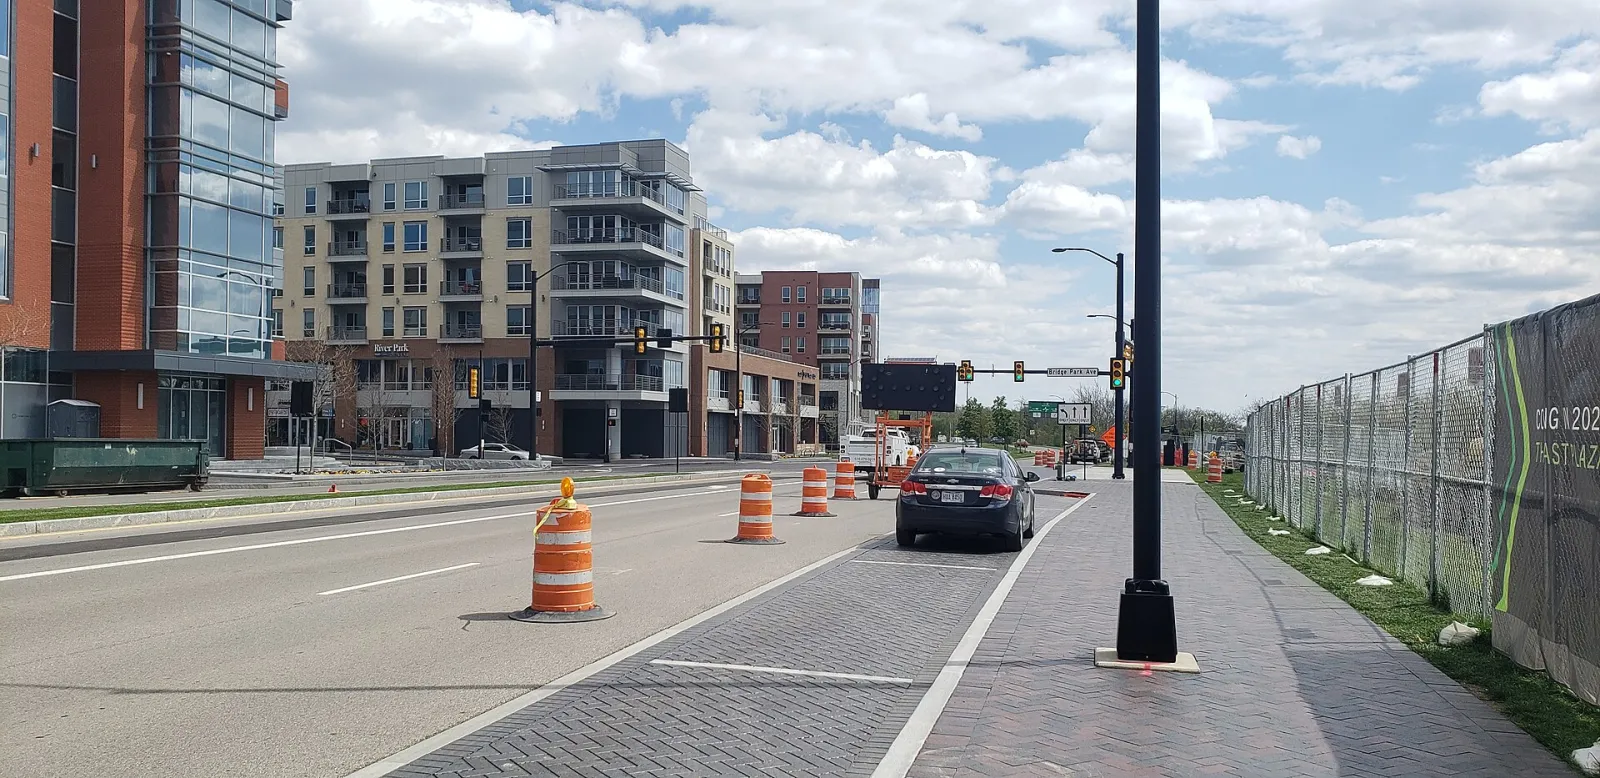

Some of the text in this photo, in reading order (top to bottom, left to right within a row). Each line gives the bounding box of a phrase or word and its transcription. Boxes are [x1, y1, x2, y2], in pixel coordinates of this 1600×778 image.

[374, 343, 409, 352] River Park
[1048, 368, 1067, 376] Bridge
